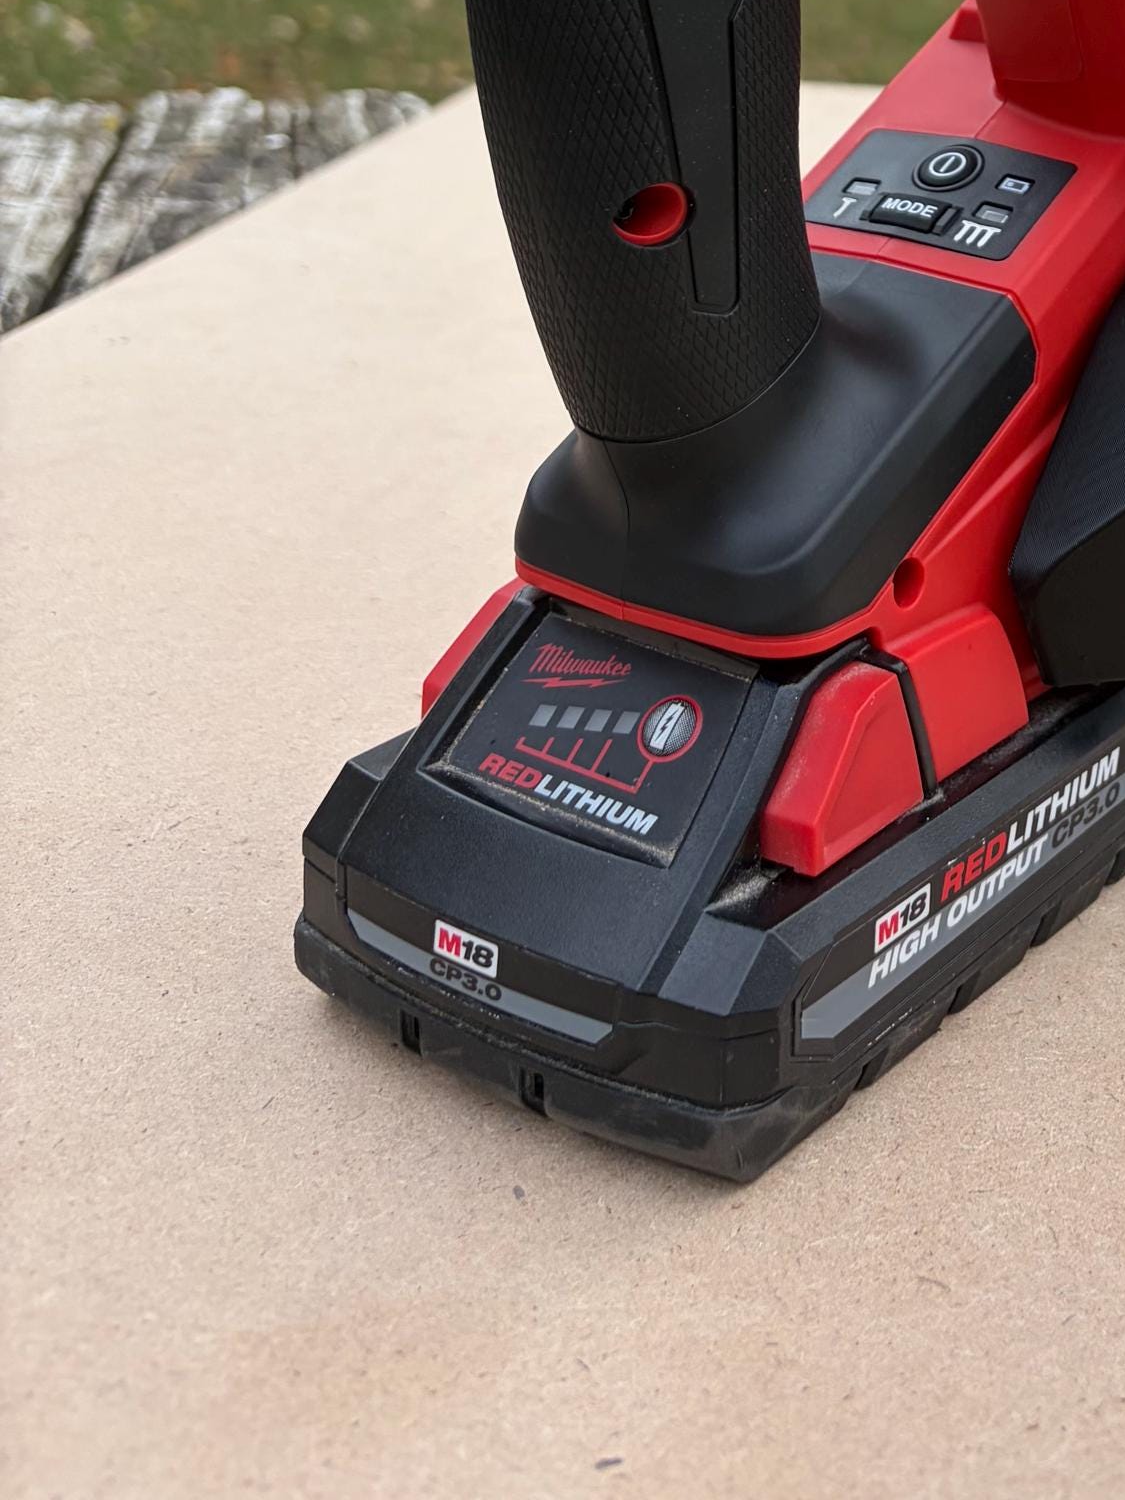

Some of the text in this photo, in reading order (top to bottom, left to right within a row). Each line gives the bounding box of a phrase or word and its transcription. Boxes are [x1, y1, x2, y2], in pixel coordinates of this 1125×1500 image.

[881, 198, 938, 218] MODE
[529, 643, 632, 676] Milwaukee
[478, 753, 658, 835] REDLITHIUM
[878, 747, 1120, 944] M18 REDLITHIUM
[868, 782, 1120, 988] HIGH OUTPUT CP3.0
[438, 927, 494, 968] M18
[430, 958, 502, 1000] CP3.0
